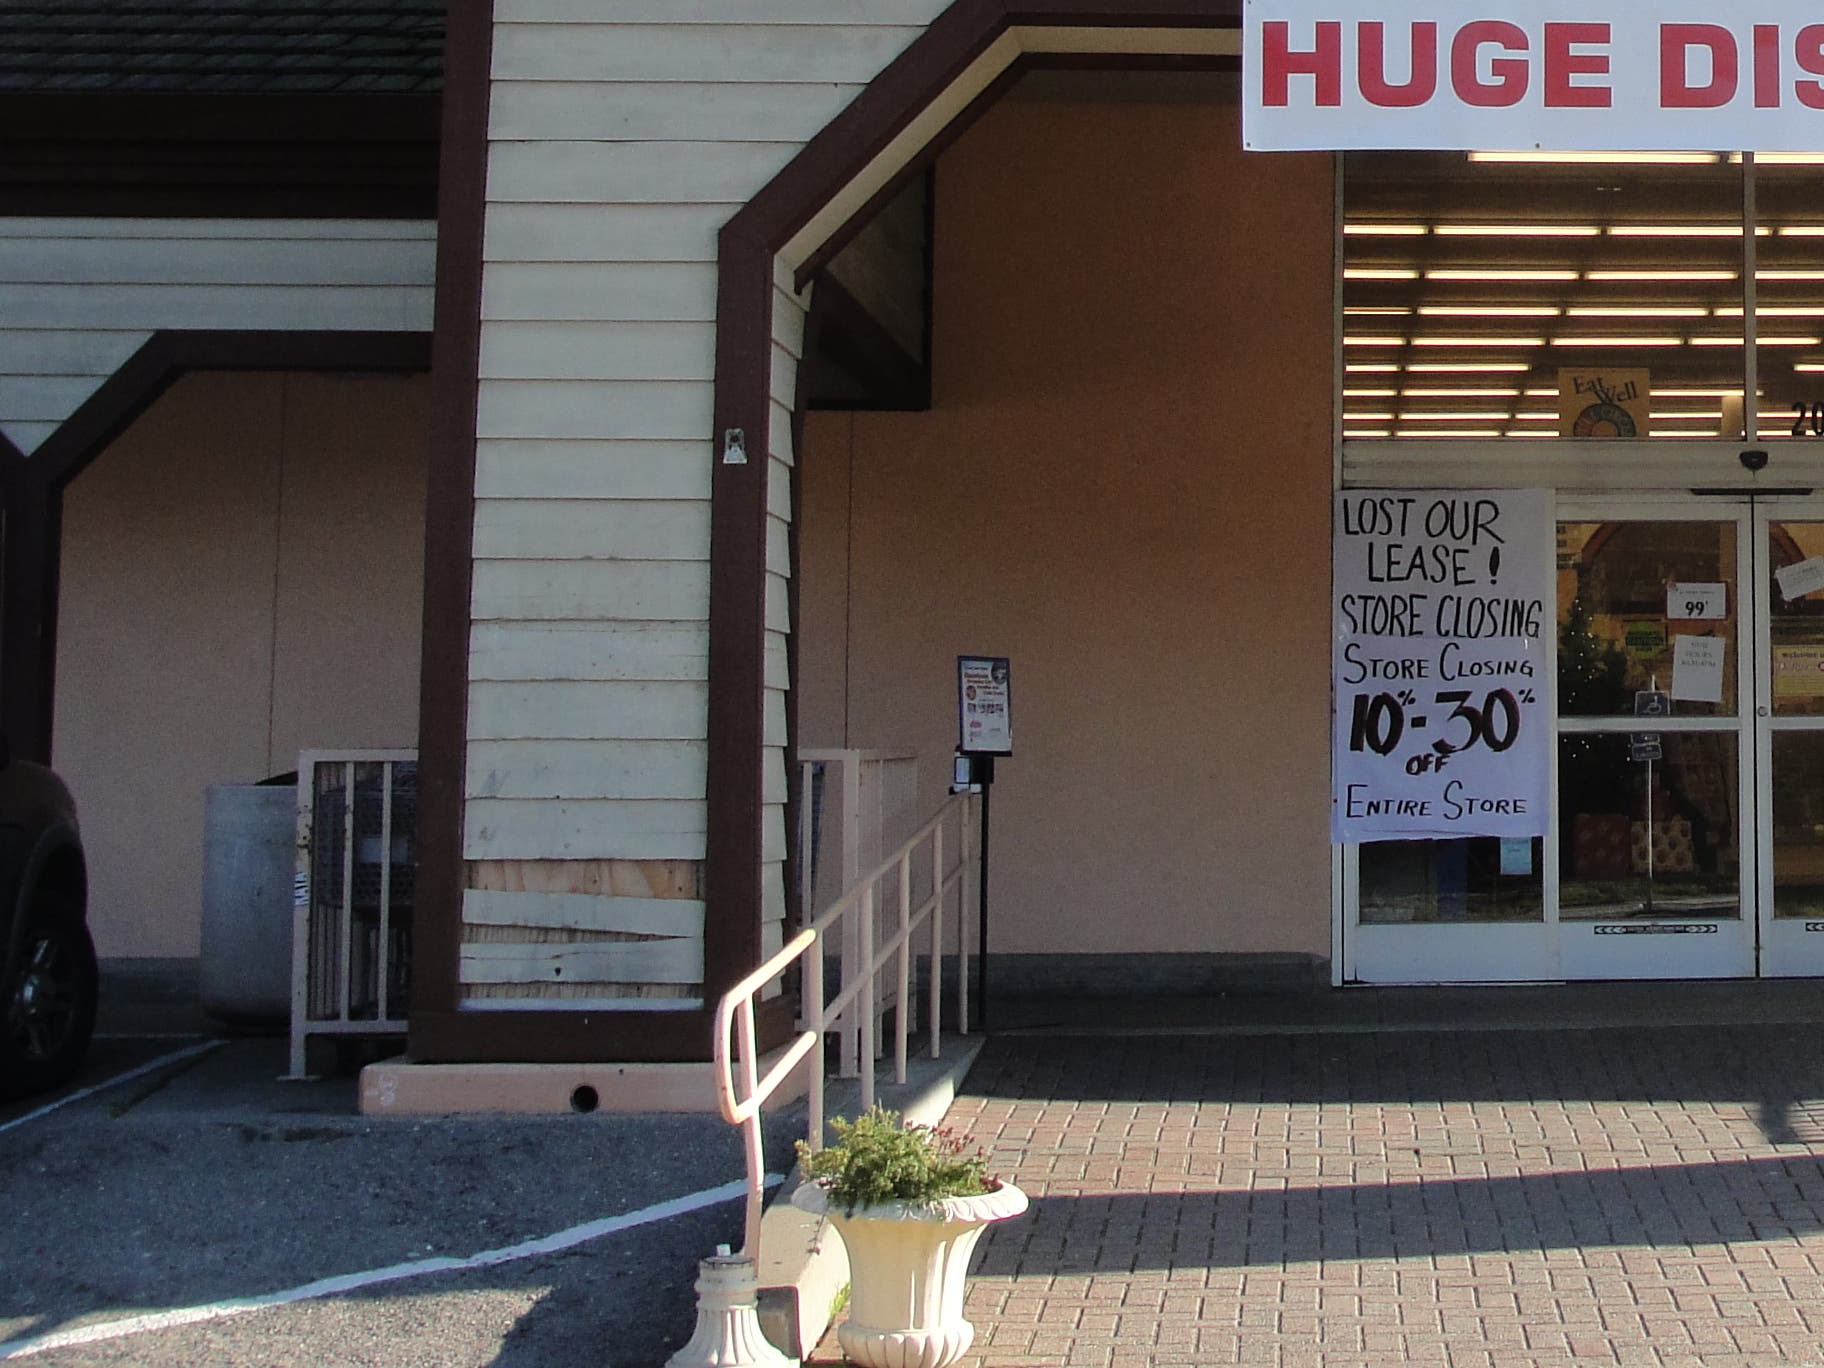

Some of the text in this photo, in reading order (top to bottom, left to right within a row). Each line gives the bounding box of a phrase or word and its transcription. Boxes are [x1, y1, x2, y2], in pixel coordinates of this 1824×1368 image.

[1261, 20, 1613, 108] HUGE
[1343, 498, 1506, 545] LOST OUR
[1341, 594, 1543, 639] STORE CLOSING
[1343, 642, 1534, 684] STORE CLOSING
[1405, 753, 1451, 776] OFF
[1346, 780, 1527, 820] ENTIRE STORE
